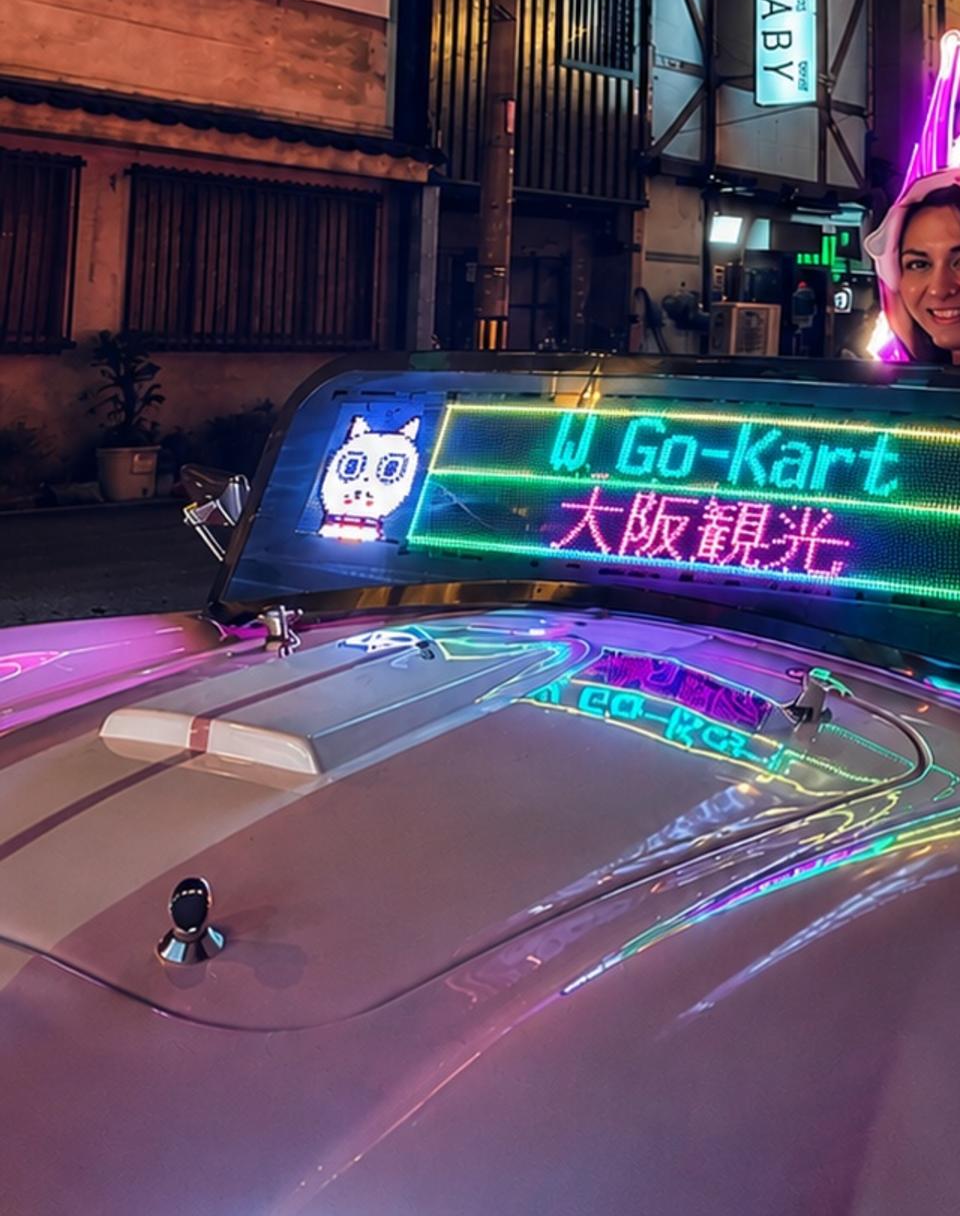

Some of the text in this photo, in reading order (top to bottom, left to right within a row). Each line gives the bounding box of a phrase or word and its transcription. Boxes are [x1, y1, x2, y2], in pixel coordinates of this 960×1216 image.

[549, 411, 900, 497] W Go-Kart
[550, 485, 851, 579] 大阪観光
